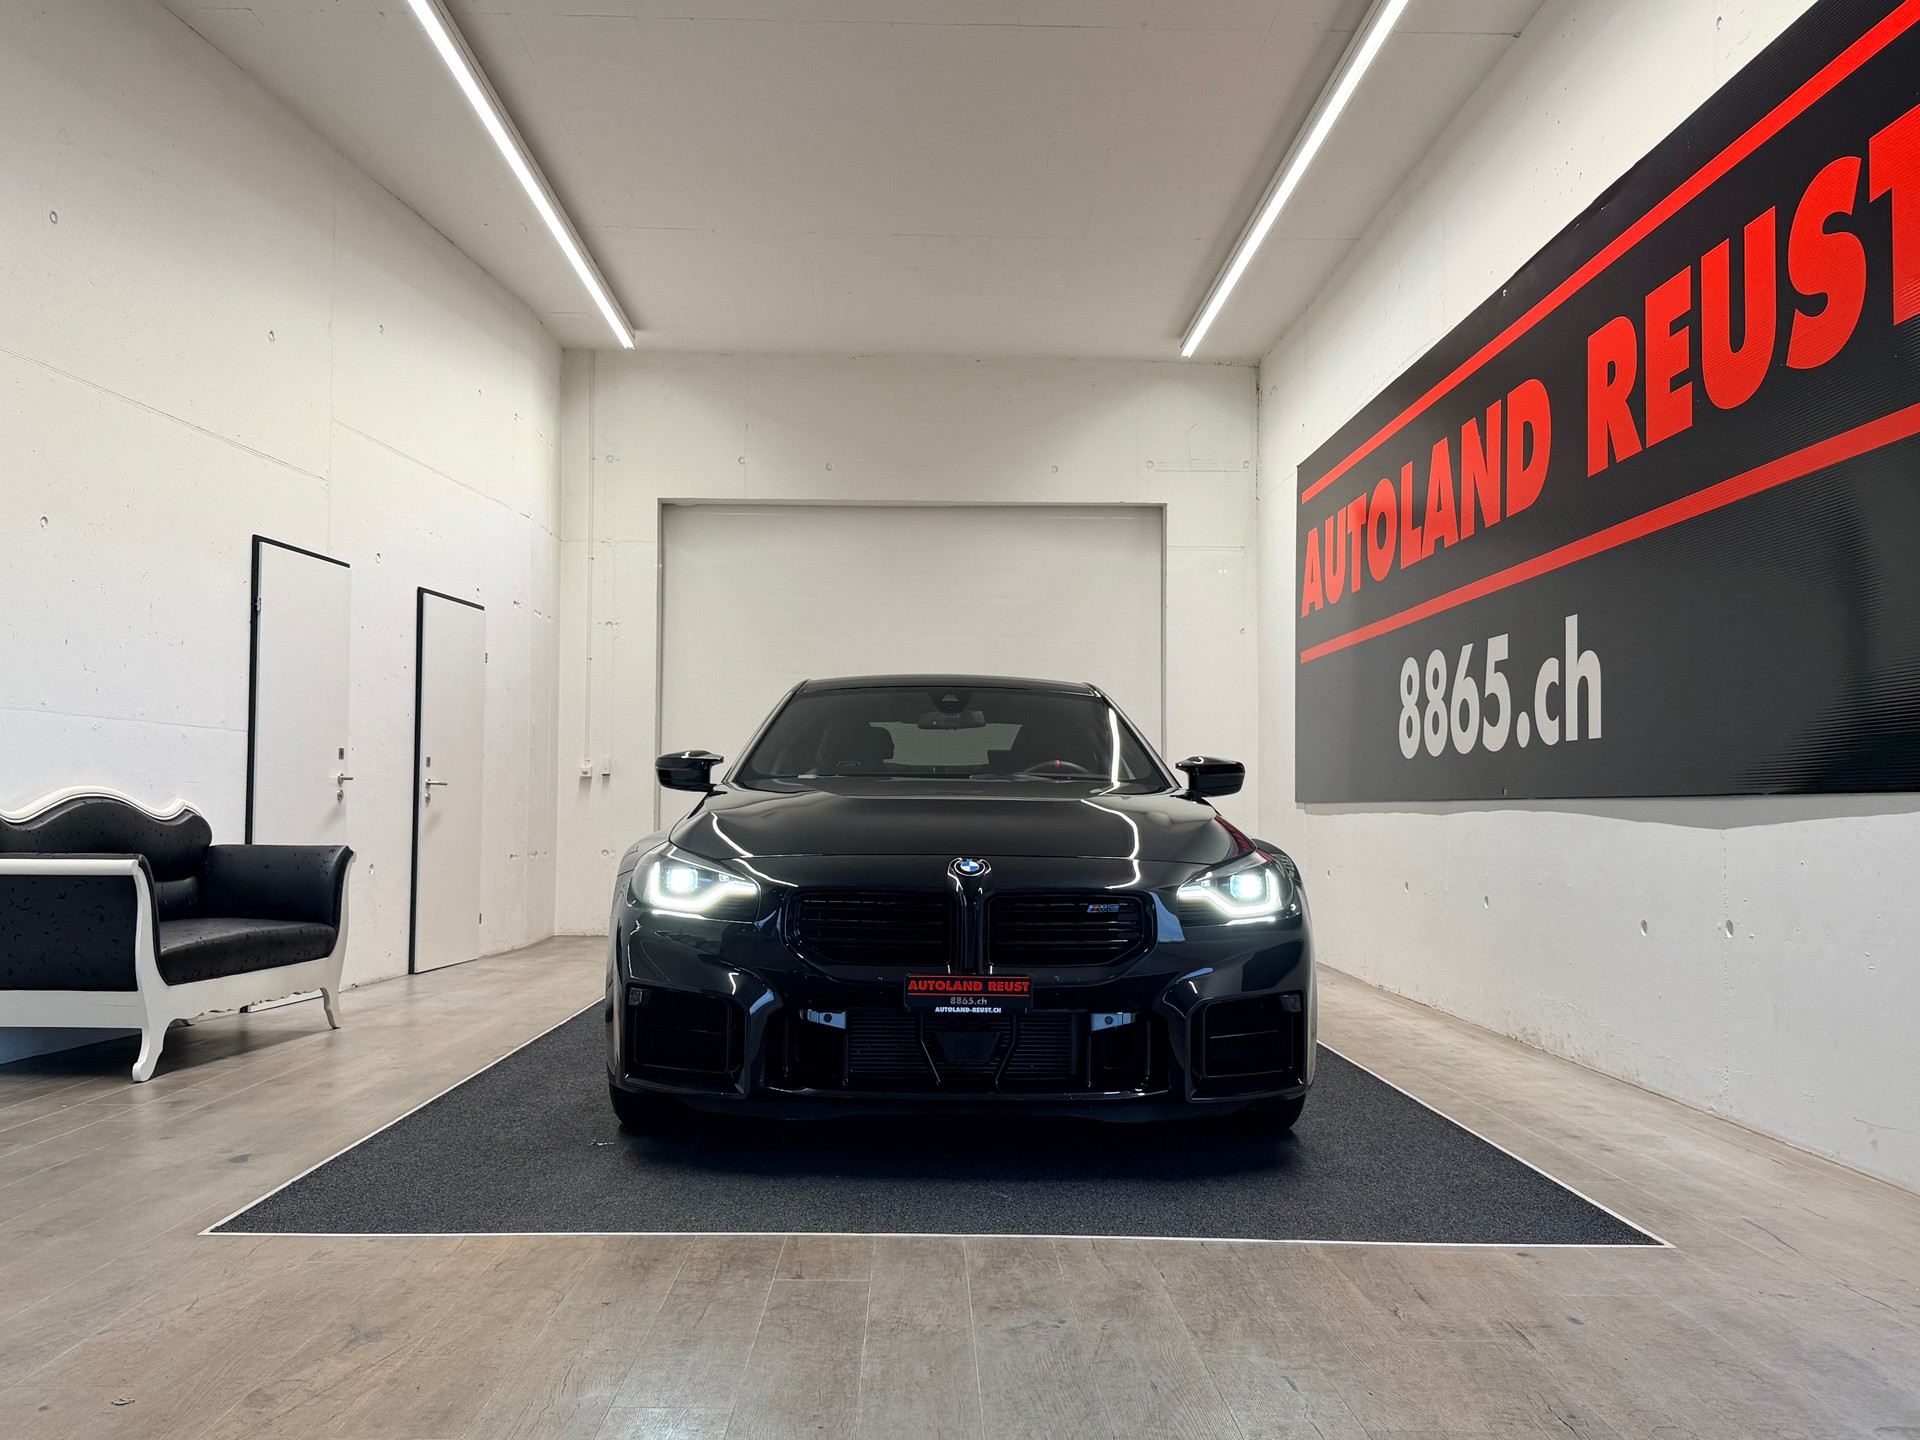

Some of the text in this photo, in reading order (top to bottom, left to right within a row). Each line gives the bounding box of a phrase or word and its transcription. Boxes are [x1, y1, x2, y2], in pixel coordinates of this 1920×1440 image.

[1301, 379, 1551, 618] AUTOLAND
[1399, 614, 1601, 760] 8865.ch
[1087, 903, 1119, 913] M2
[908, 980, 1029, 992] AUTOLAND REUST
[950, 996, 987, 1005] 8865.ch
